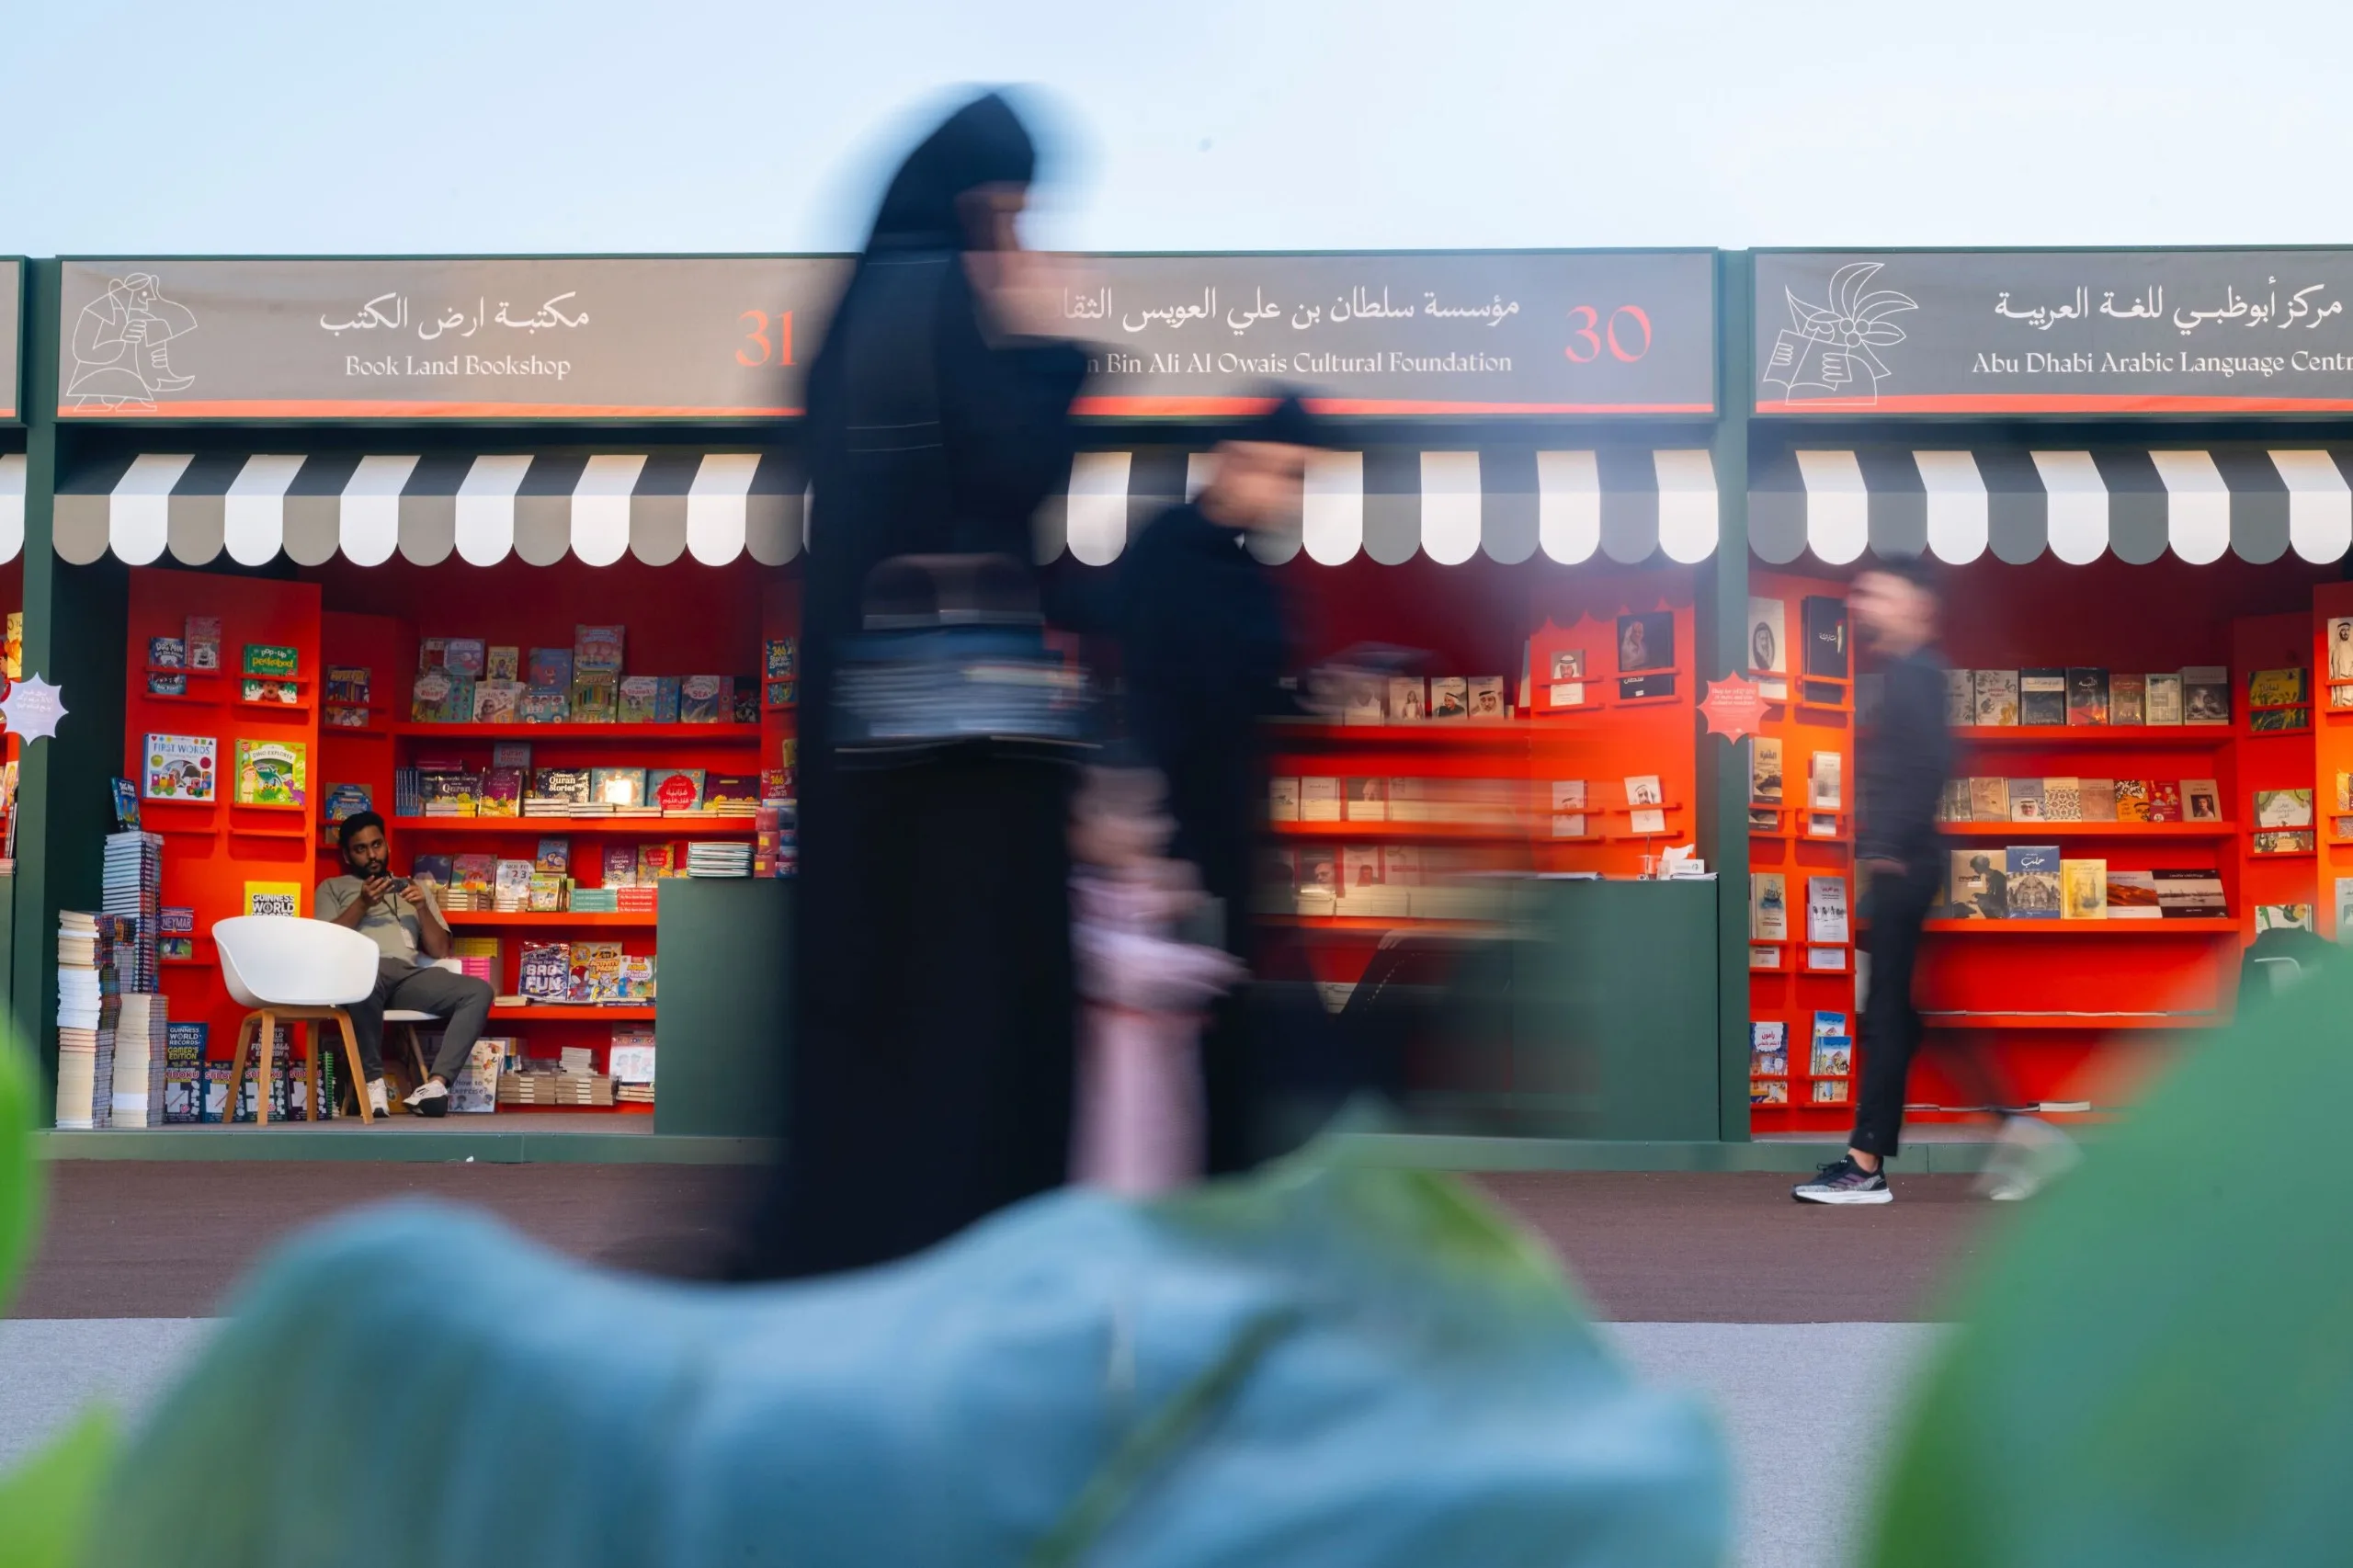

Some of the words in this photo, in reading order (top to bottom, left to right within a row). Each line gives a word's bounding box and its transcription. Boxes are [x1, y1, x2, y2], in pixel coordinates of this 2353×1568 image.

[319, 291, 408, 337] الكتب
[494, 290, 590, 335] مكتبة
[1121, 286, 1217, 333] العويس
[1226, 285, 1281, 336] علي
[1290, 303, 1321, 330] بن
[1329, 285, 1415, 324] سلطان
[1423, 291, 1520, 327] مؤسسة
[1994, 285, 2089, 331] العربية
[2098, 284, 2164, 319] للغة
[2173, 275, 2278, 334] أبوظبي
[2277, 283, 2344, 331] مركز
[418, 296, 484, 341] ارض
[1564, 304, 1652, 364] 30
[735, 309, 795, 368] 31
[345, 355, 400, 376] Book
[405, 355, 459, 376] Land
[464, 355, 572, 381] Bookshop
[1106, 353, 1142, 373] Bin
[1148, 353, 1180, 373] Ali
[1186, 353, 1212, 373] Al
[1217, 353, 1288, 373] Owais
[1293, 352, 1383, 373] Cultural
[1388, 351, 1512, 372] Foundation
[1971, 352, 2020, 373] Abu
[2025, 352, 2095, 373] Dhabi
[2099, 351, 2174, 373] Arabic
[2179, 351, 2285, 379] Language
[153, 743, 175, 753] FIRST
[178, 744, 210, 755] WORDS
[253, 750, 267, 758] DINO
[267, 750, 293, 760] EXPLORER
[442, 783, 471, 793] Quran
[549, 777, 576, 785] Quran
[549, 784, 575, 792] Stories
[252, 894, 295, 903] GUINNESS
[253, 903, 295, 913] WORLD
[162, 916, 191, 928] NEYMAR
[526, 977, 562, 990] FUN
